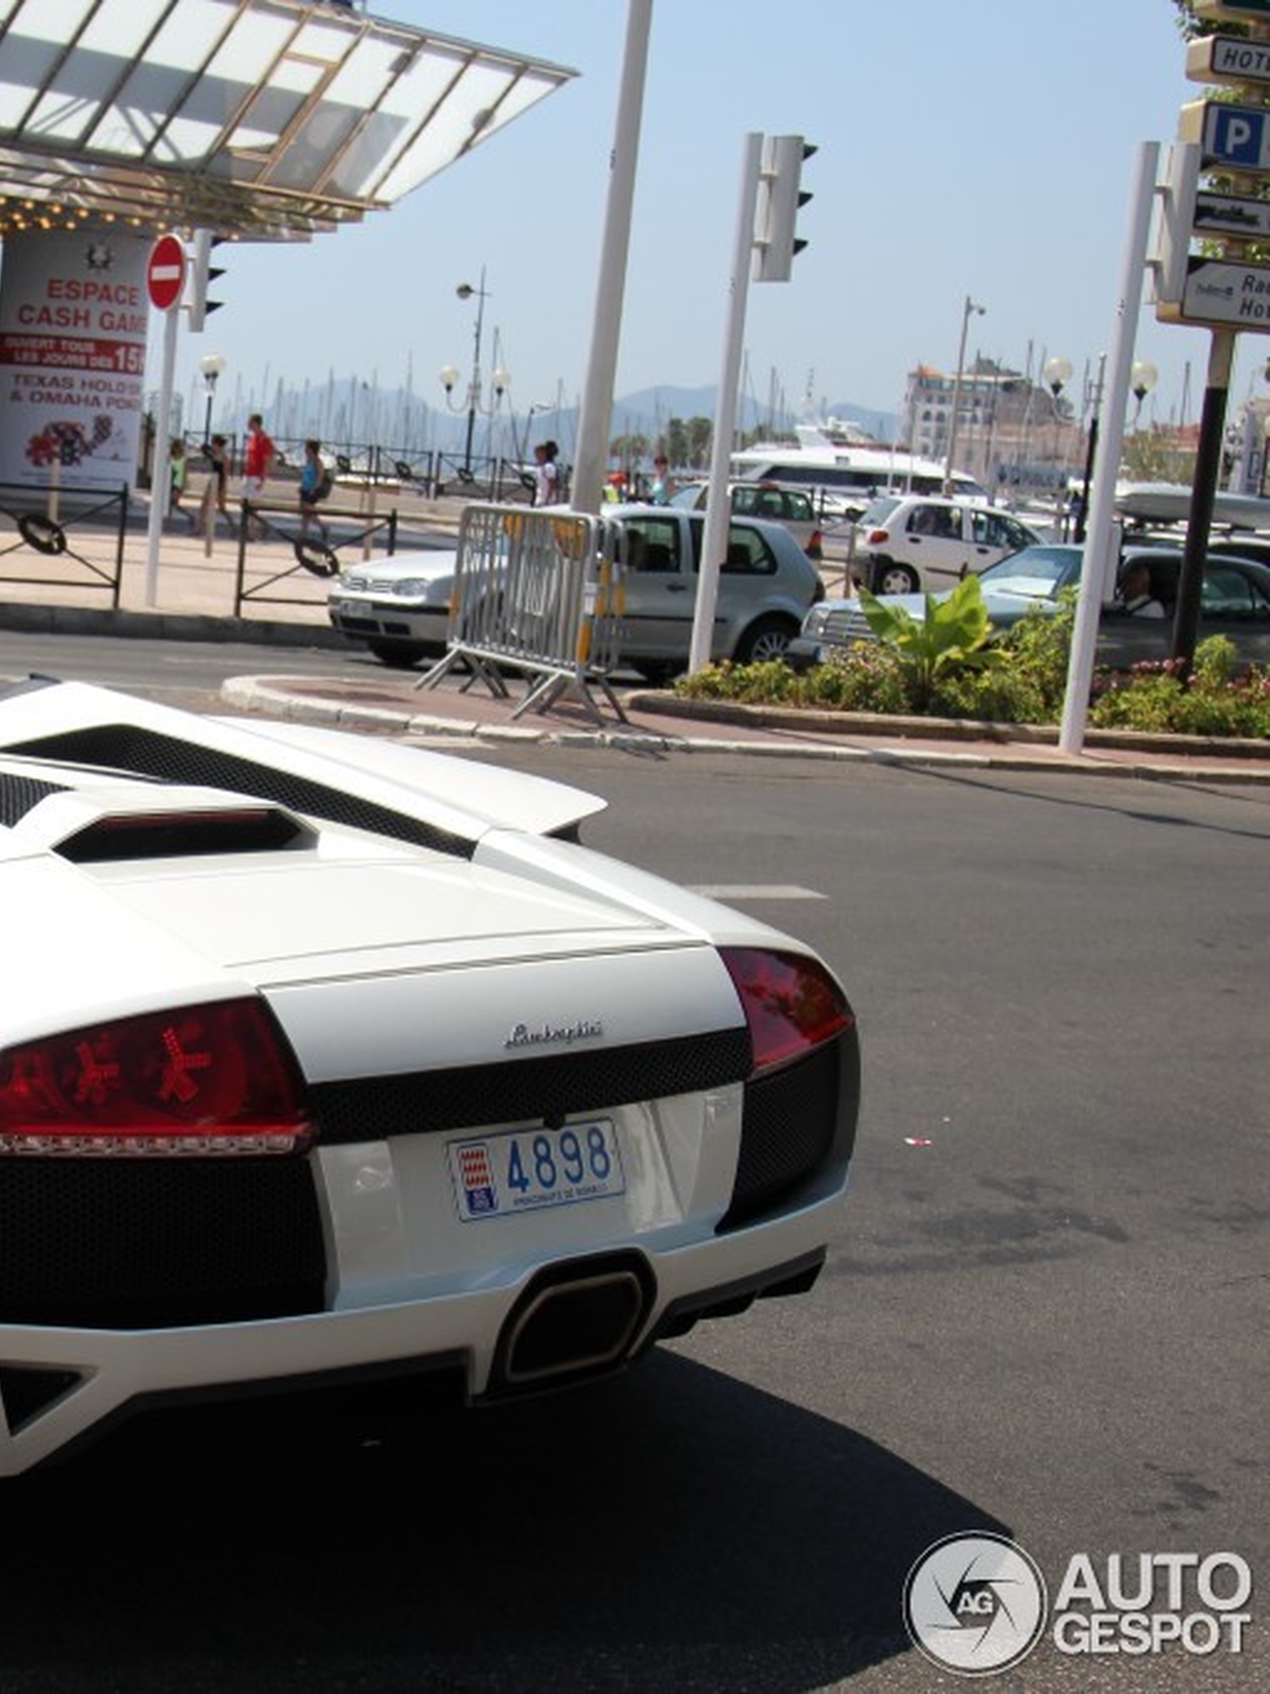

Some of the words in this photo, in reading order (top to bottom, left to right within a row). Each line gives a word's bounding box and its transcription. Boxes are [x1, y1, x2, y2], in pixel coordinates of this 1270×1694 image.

[1226, 118, 1250, 154] P
[47, 279, 139, 307] ESPACE
[18, 304, 90, 329] CASH
[12, 373, 74, 389] TEXAS
[10, 390, 23, 402] &
[30, 391, 102, 408] OMAHA
[508, 1126, 611, 1193] 4898
